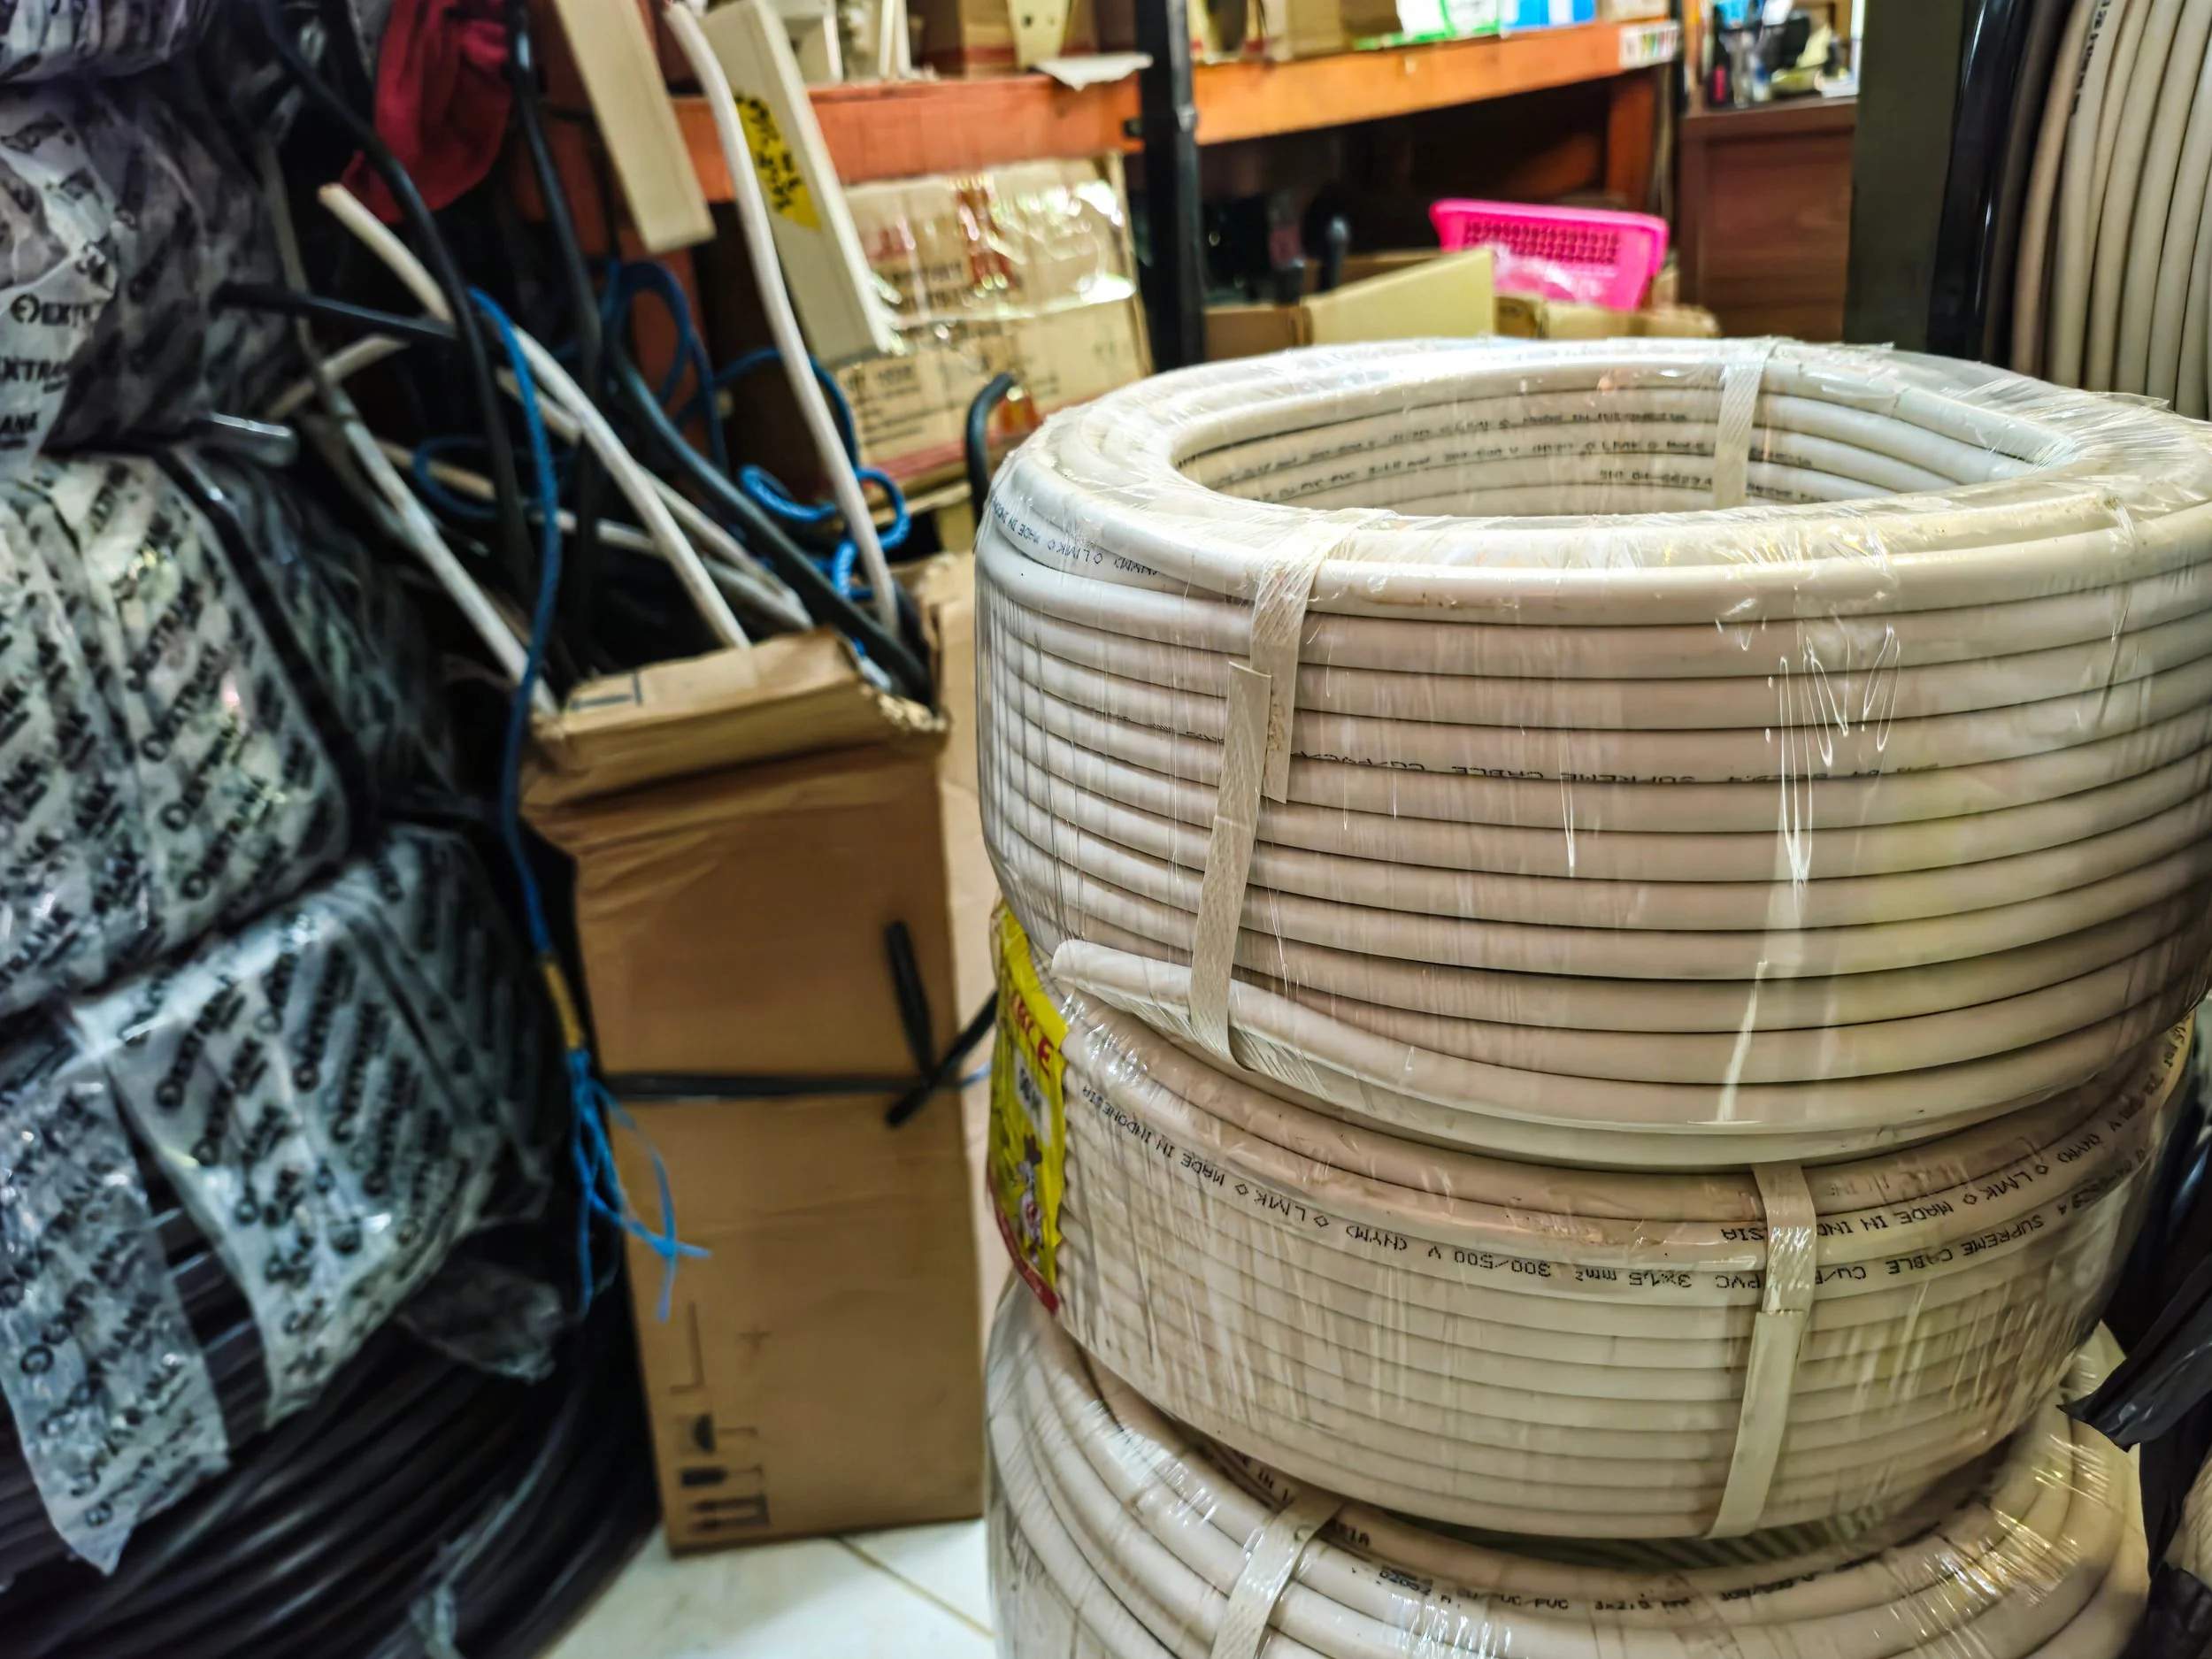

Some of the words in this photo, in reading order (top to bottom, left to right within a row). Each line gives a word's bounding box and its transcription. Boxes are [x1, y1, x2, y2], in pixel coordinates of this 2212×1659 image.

[1082, 1085, 1153, 1147] INDONESIA
[1156, 1138, 1175, 1159] IN
[1179, 1152, 1225, 1187] MADE
[1982, 1170, 2034, 1202] LMK
[1255, 1191, 1307, 1222] LMK
[1893, 1201, 1955, 1225] MADE
[1860, 1214, 1889, 1233] IN
[1961, 1213, 2045, 1258] SUPREME
[1427, 1246, 1442, 1261] V
[1454, 1248, 1552, 1278] 300/500
